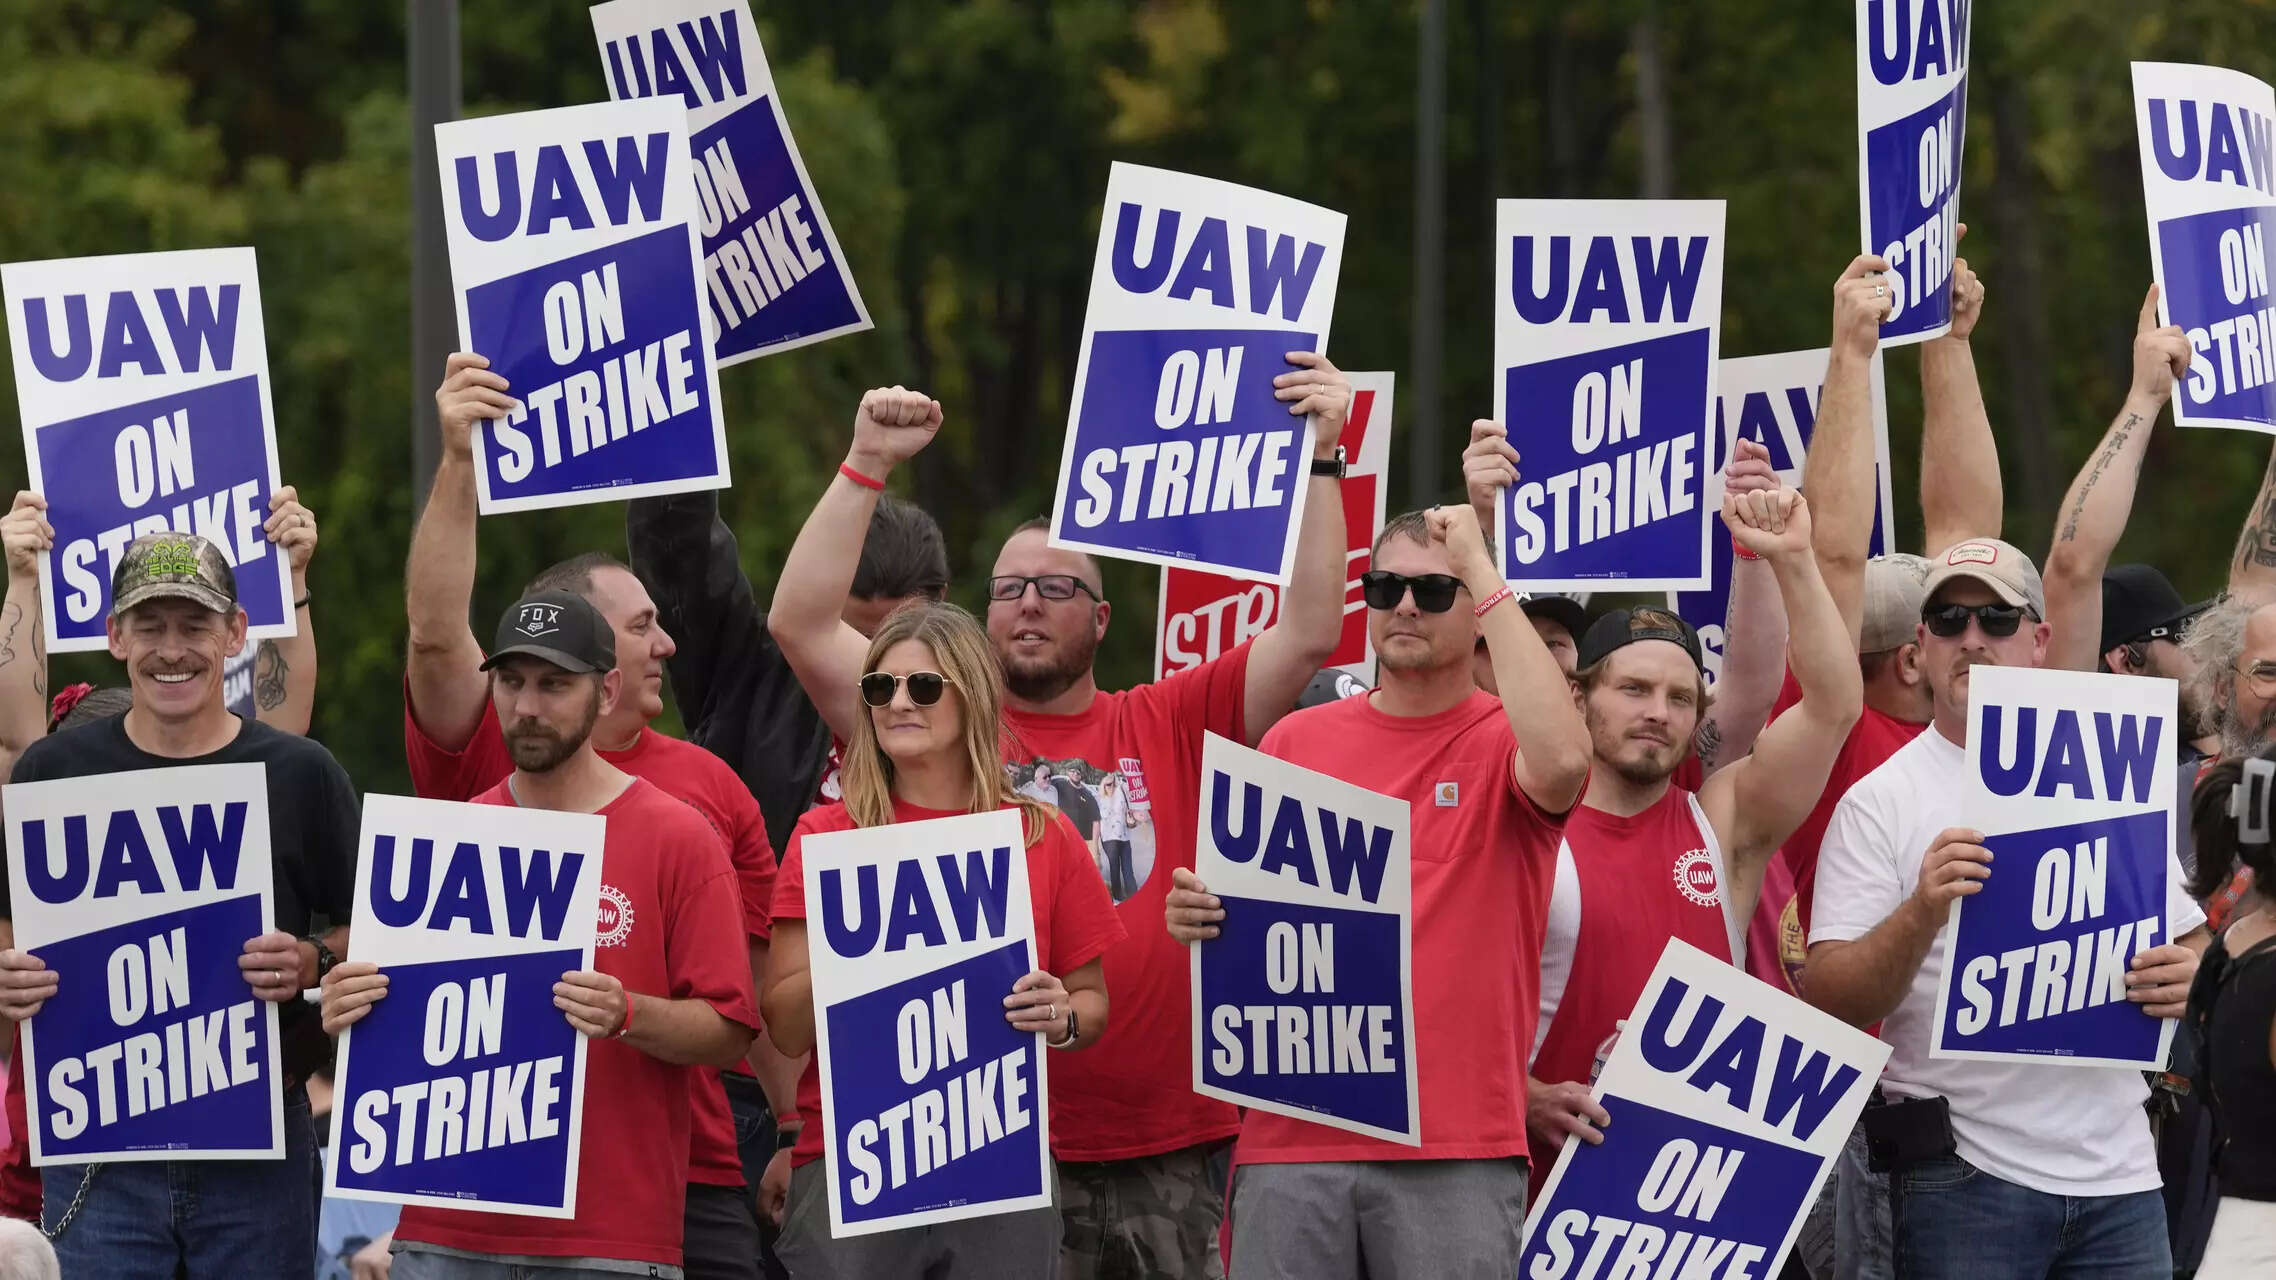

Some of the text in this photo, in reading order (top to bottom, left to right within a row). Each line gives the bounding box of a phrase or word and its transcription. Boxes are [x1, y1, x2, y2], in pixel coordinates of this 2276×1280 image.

[606, 9, 747, 110] UAW
[1868, 0, 1968, 85] UAW
[455, 132, 669, 242] UAW
[692, 136, 751, 239] ON
[1919, 107, 1953, 208] ON
[2148, 98, 2274, 197] UAW
[1111, 202, 1325, 322] UAW
[1512, 236, 1709, 324] UAW
[1882, 182, 1960, 323] STRI
[2219, 222, 2269, 305] ON
[23, 284, 240, 382] UAW
[543, 262, 625, 366] ON
[2187, 307, 2276, 405] STRI
[495, 330, 699, 483] STRIKE
[1155, 346, 1243, 430] ON
[1572, 358, 1642, 455] ON
[115, 408, 194, 508] ON
[1075, 430, 1293, 528] STRIKE
[1515, 432, 1695, 564] STRIKE
[62, 479, 266, 623] STKE
[149, 562, 197, 577] EDGE
[520, 608, 558, 623] FOX
[1979, 704, 2163, 804] UAW
[22, 801, 248, 904] UAW
[1210, 770, 1393, 904] UAW
[1690, 870, 1714, 884] UAW
[2031, 837, 2108, 932] ON
[370, 834, 584, 941] UAW
[597, 908, 617, 924] AW
[819, 846, 1011, 959] UAW
[106, 927, 190, 1027] ON
[1265, 921, 1334, 994] ON
[1786, 921, 1800, 955] THE
[423, 973, 507, 1067] ON
[897, 979, 968, 1085] ON
[1211, 1005, 1397, 1076] STRIKE
[1639, 975, 1862, 1142] UAW
[48, 1000, 259, 1141] STRIKE
[350, 1055, 563, 1175] STRIKE
[846, 1046, 1030, 1206] STRIKE
[1637, 1138, 1746, 1223] ON
